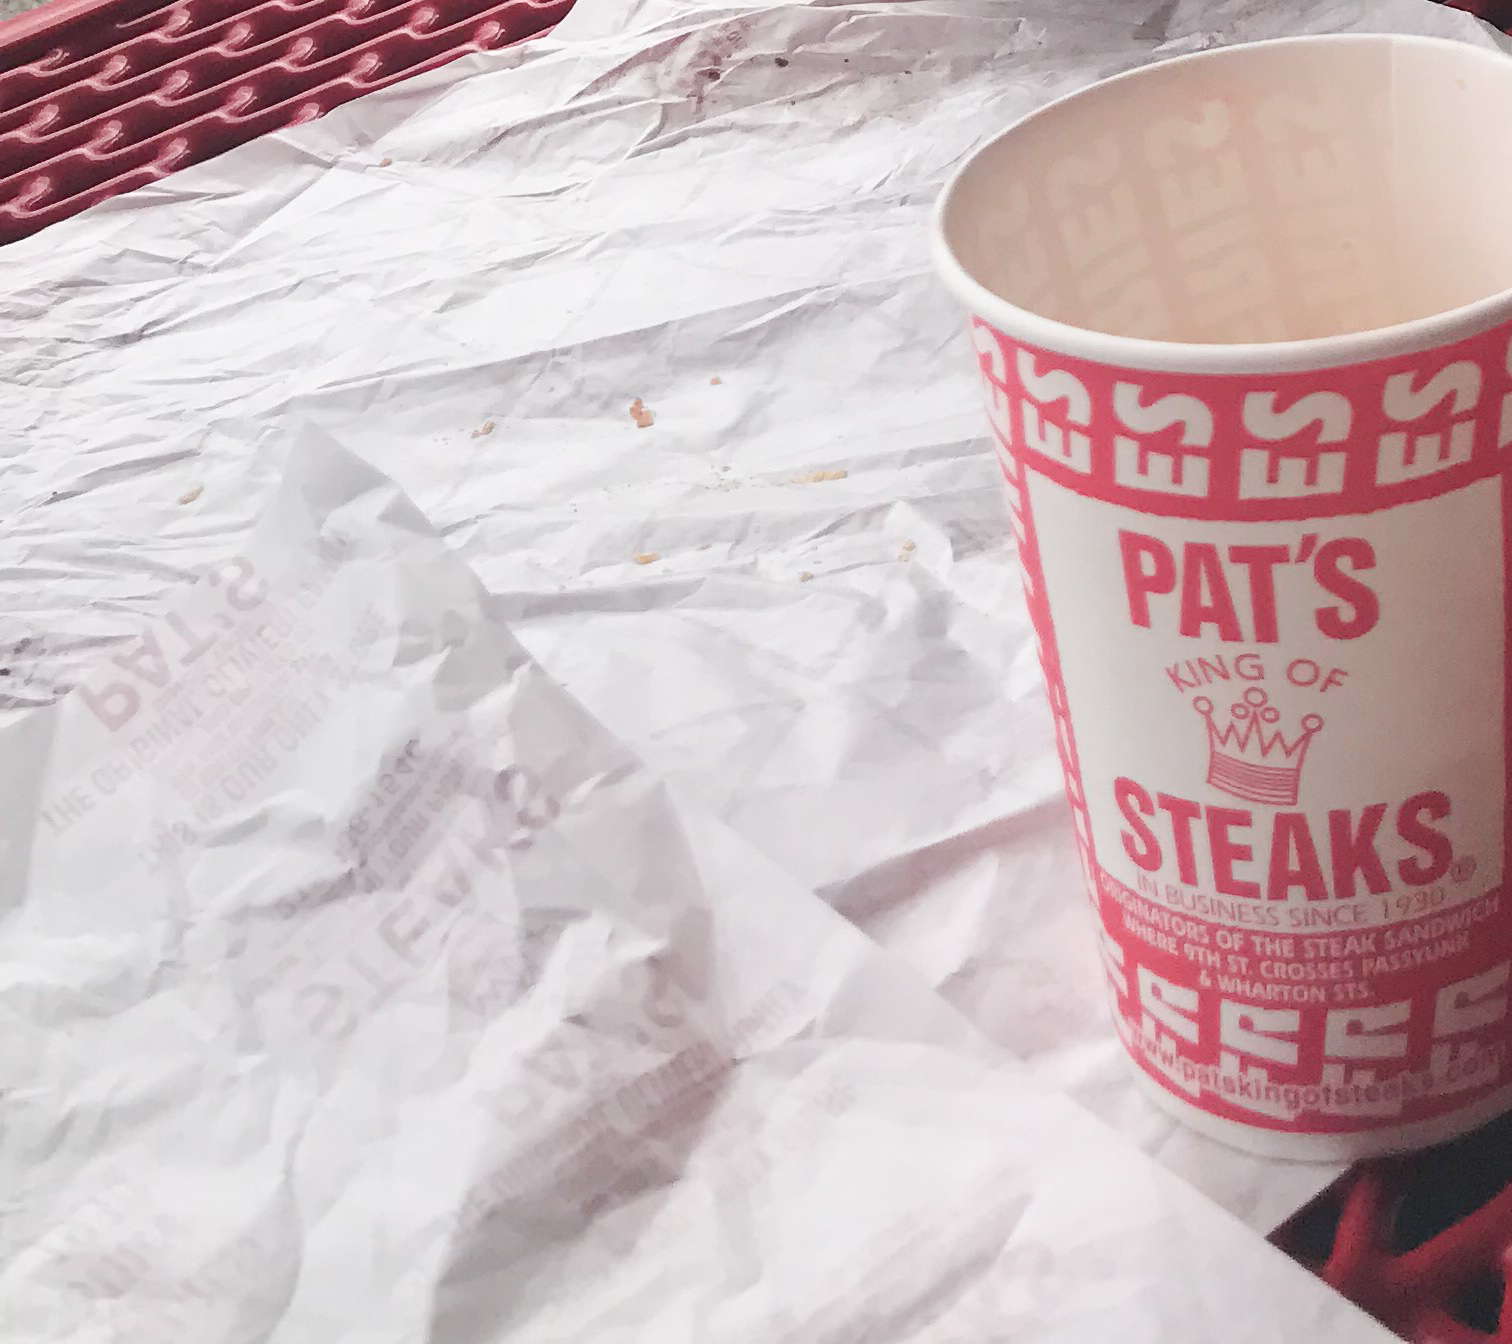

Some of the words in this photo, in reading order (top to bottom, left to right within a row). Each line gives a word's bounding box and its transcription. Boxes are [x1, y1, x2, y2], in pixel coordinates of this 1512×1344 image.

[1118, 529, 1380, 643] PAT'S
[1166, 653, 1265, 693] KING
[1286, 659, 1349, 692] OF
[1114, 776, 1454, 902] STEAKS
[1100, 873, 1210, 944] ORIGINATORS
[1215, 929, 1245, 952] OF
[1251, 935, 1295, 958] THE
[1303, 932, 1377, 959] STEAK
[1384, 894, 1500, 951] SANDWICH
[1137, 871, 1159, 897] IN
[1165, 883, 1280, 927] BUSINESS
[1288, 904, 1369, 927] SINCE
[1381, 886, 1445, 920] 1930
[1122, 911, 1179, 956] WHERE
[1183, 942, 1222, 968] 9TH
[1259, 960, 1354, 981] CROSSES
[1361, 930, 1470, 977] PASSYUNK
[1199, 969, 1213, 988] &
[1217, 974, 1326, 1002] WHARTON
